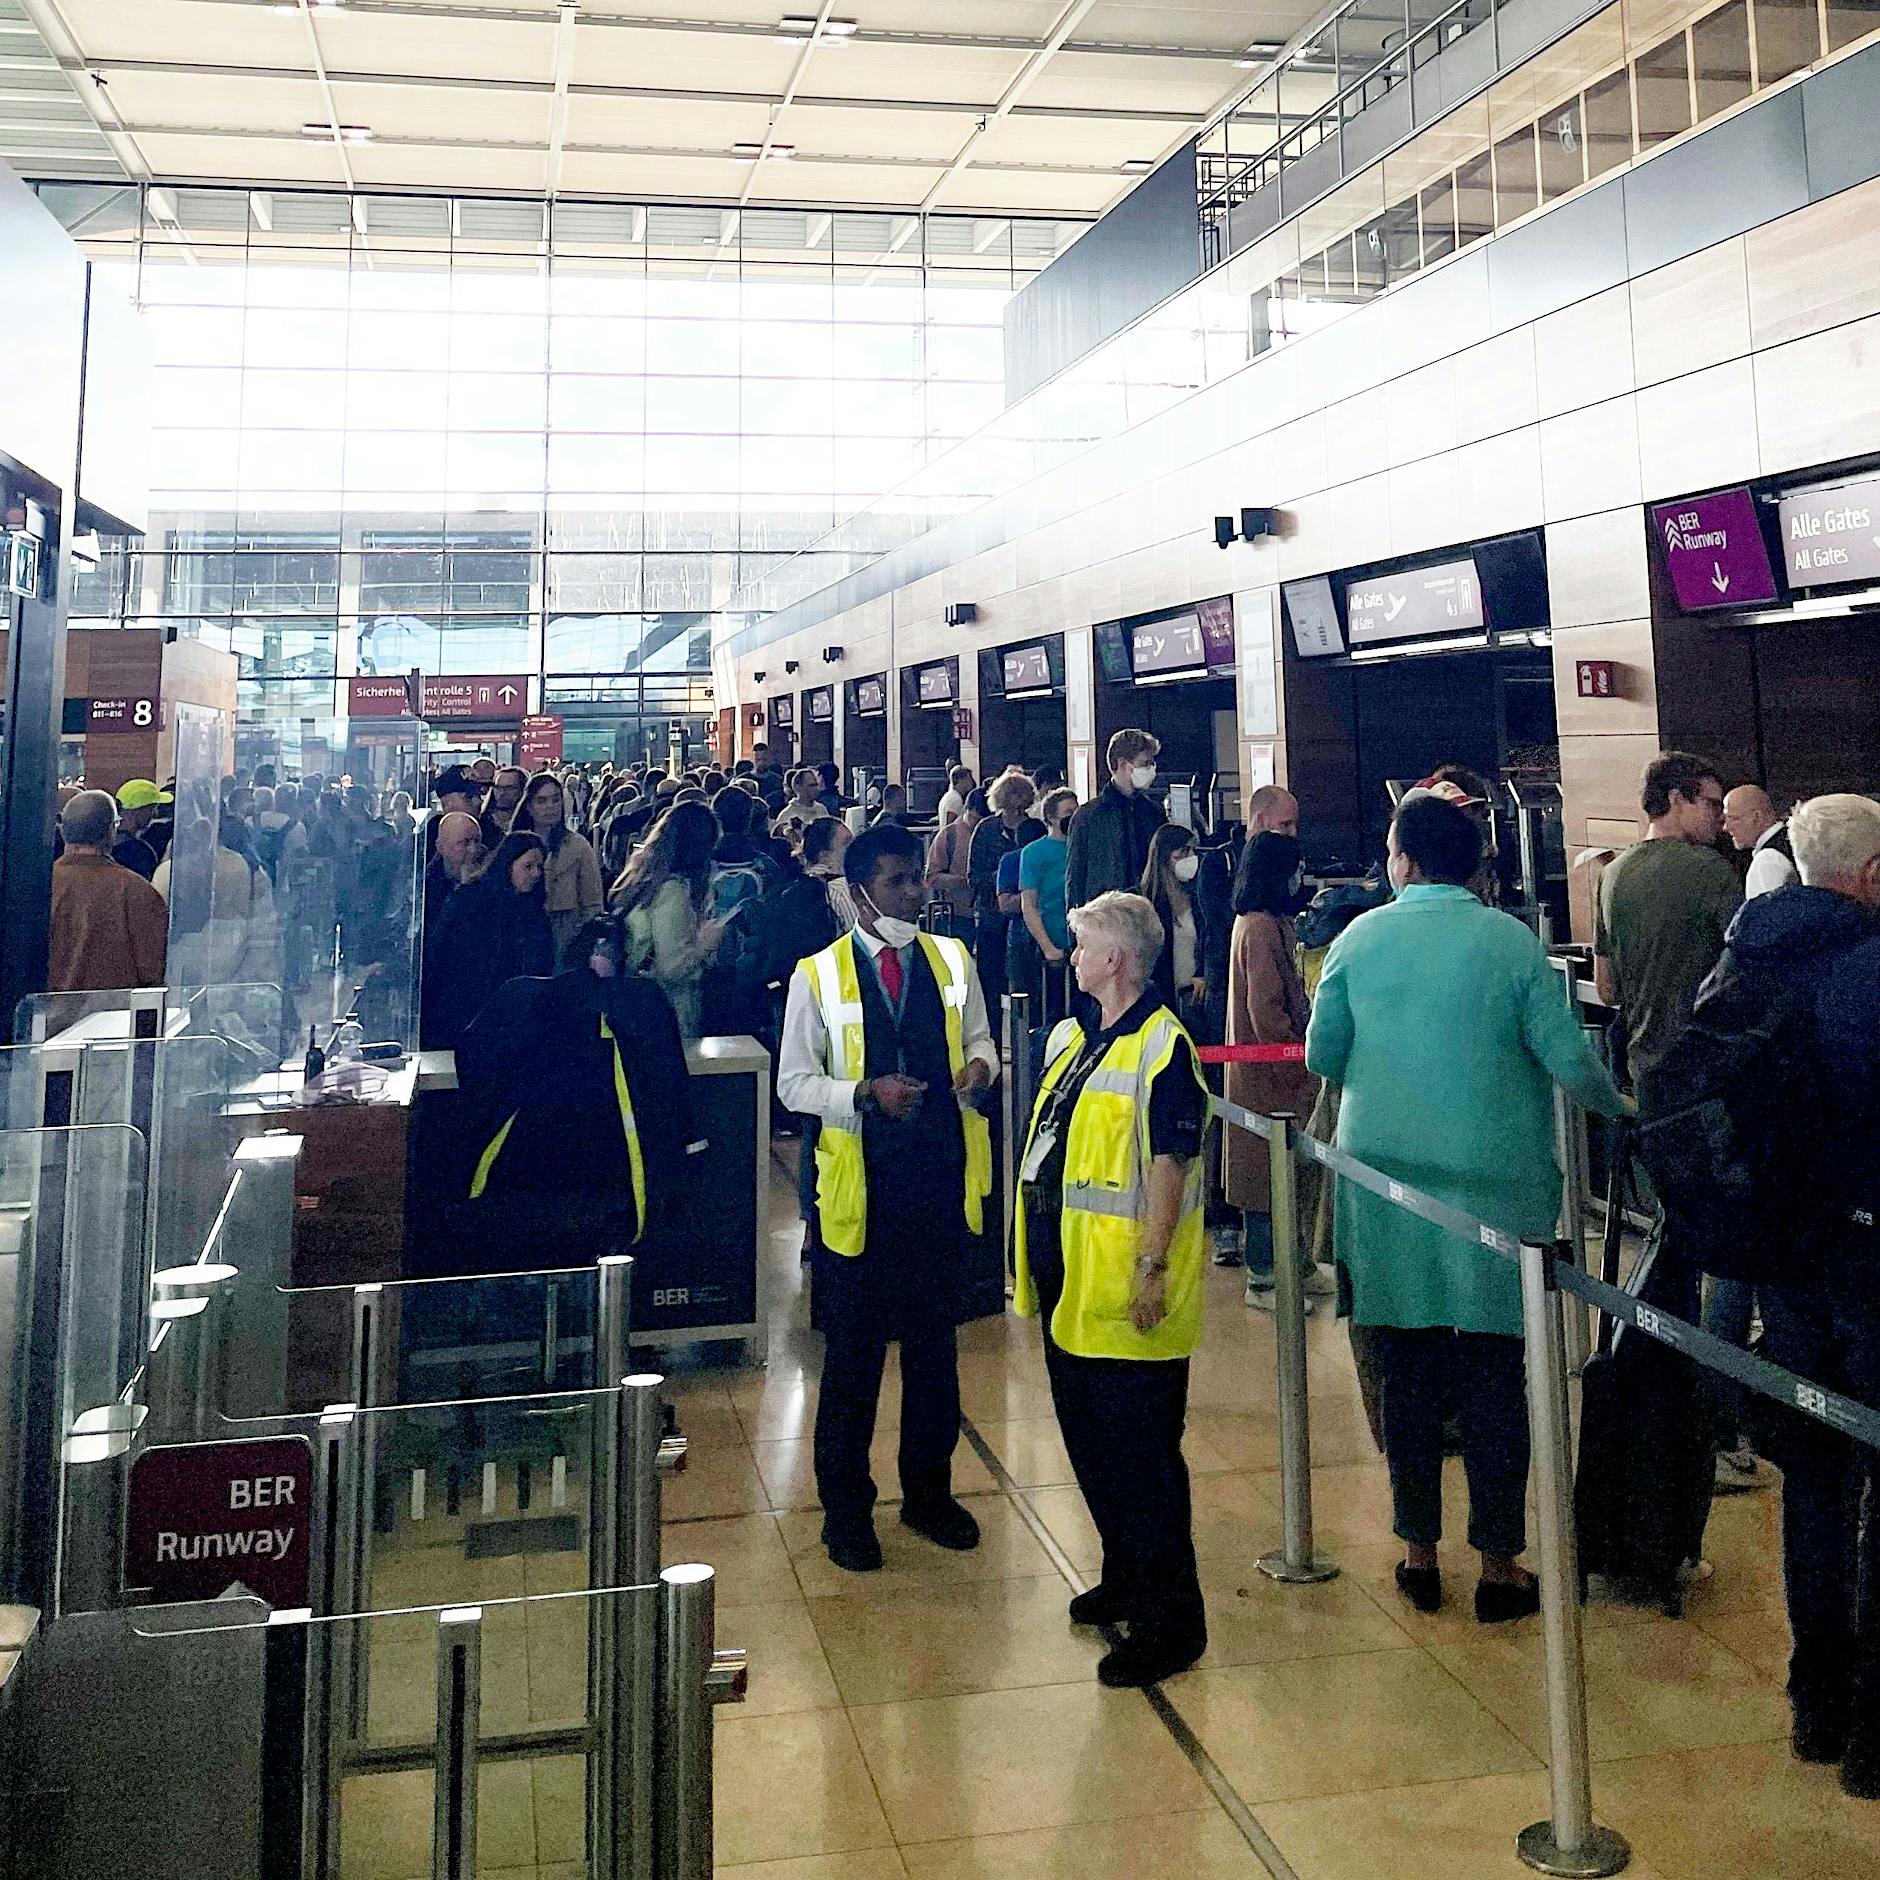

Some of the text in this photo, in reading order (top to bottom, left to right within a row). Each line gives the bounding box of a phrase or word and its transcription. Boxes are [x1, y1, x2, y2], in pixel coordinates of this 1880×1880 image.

[1678, 511, 1701, 532] BER
[1791, 506, 1871, 540] Alle Gates
[1683, 529, 1727, 551] Runway
[1795, 547, 1849, 571] All Gates
[1349, 591, 1384, 612] Alle Gates
[441, 697, 472, 707] Control
[466, 685, 473, 696] 5
[93, 700, 152, 726] Check-in 8
[653, 1288, 690, 1306] BER
[1635, 1305, 1660, 1336] BER
[230, 1475, 296, 1510] BER
[156, 1528, 295, 1562] Runway
